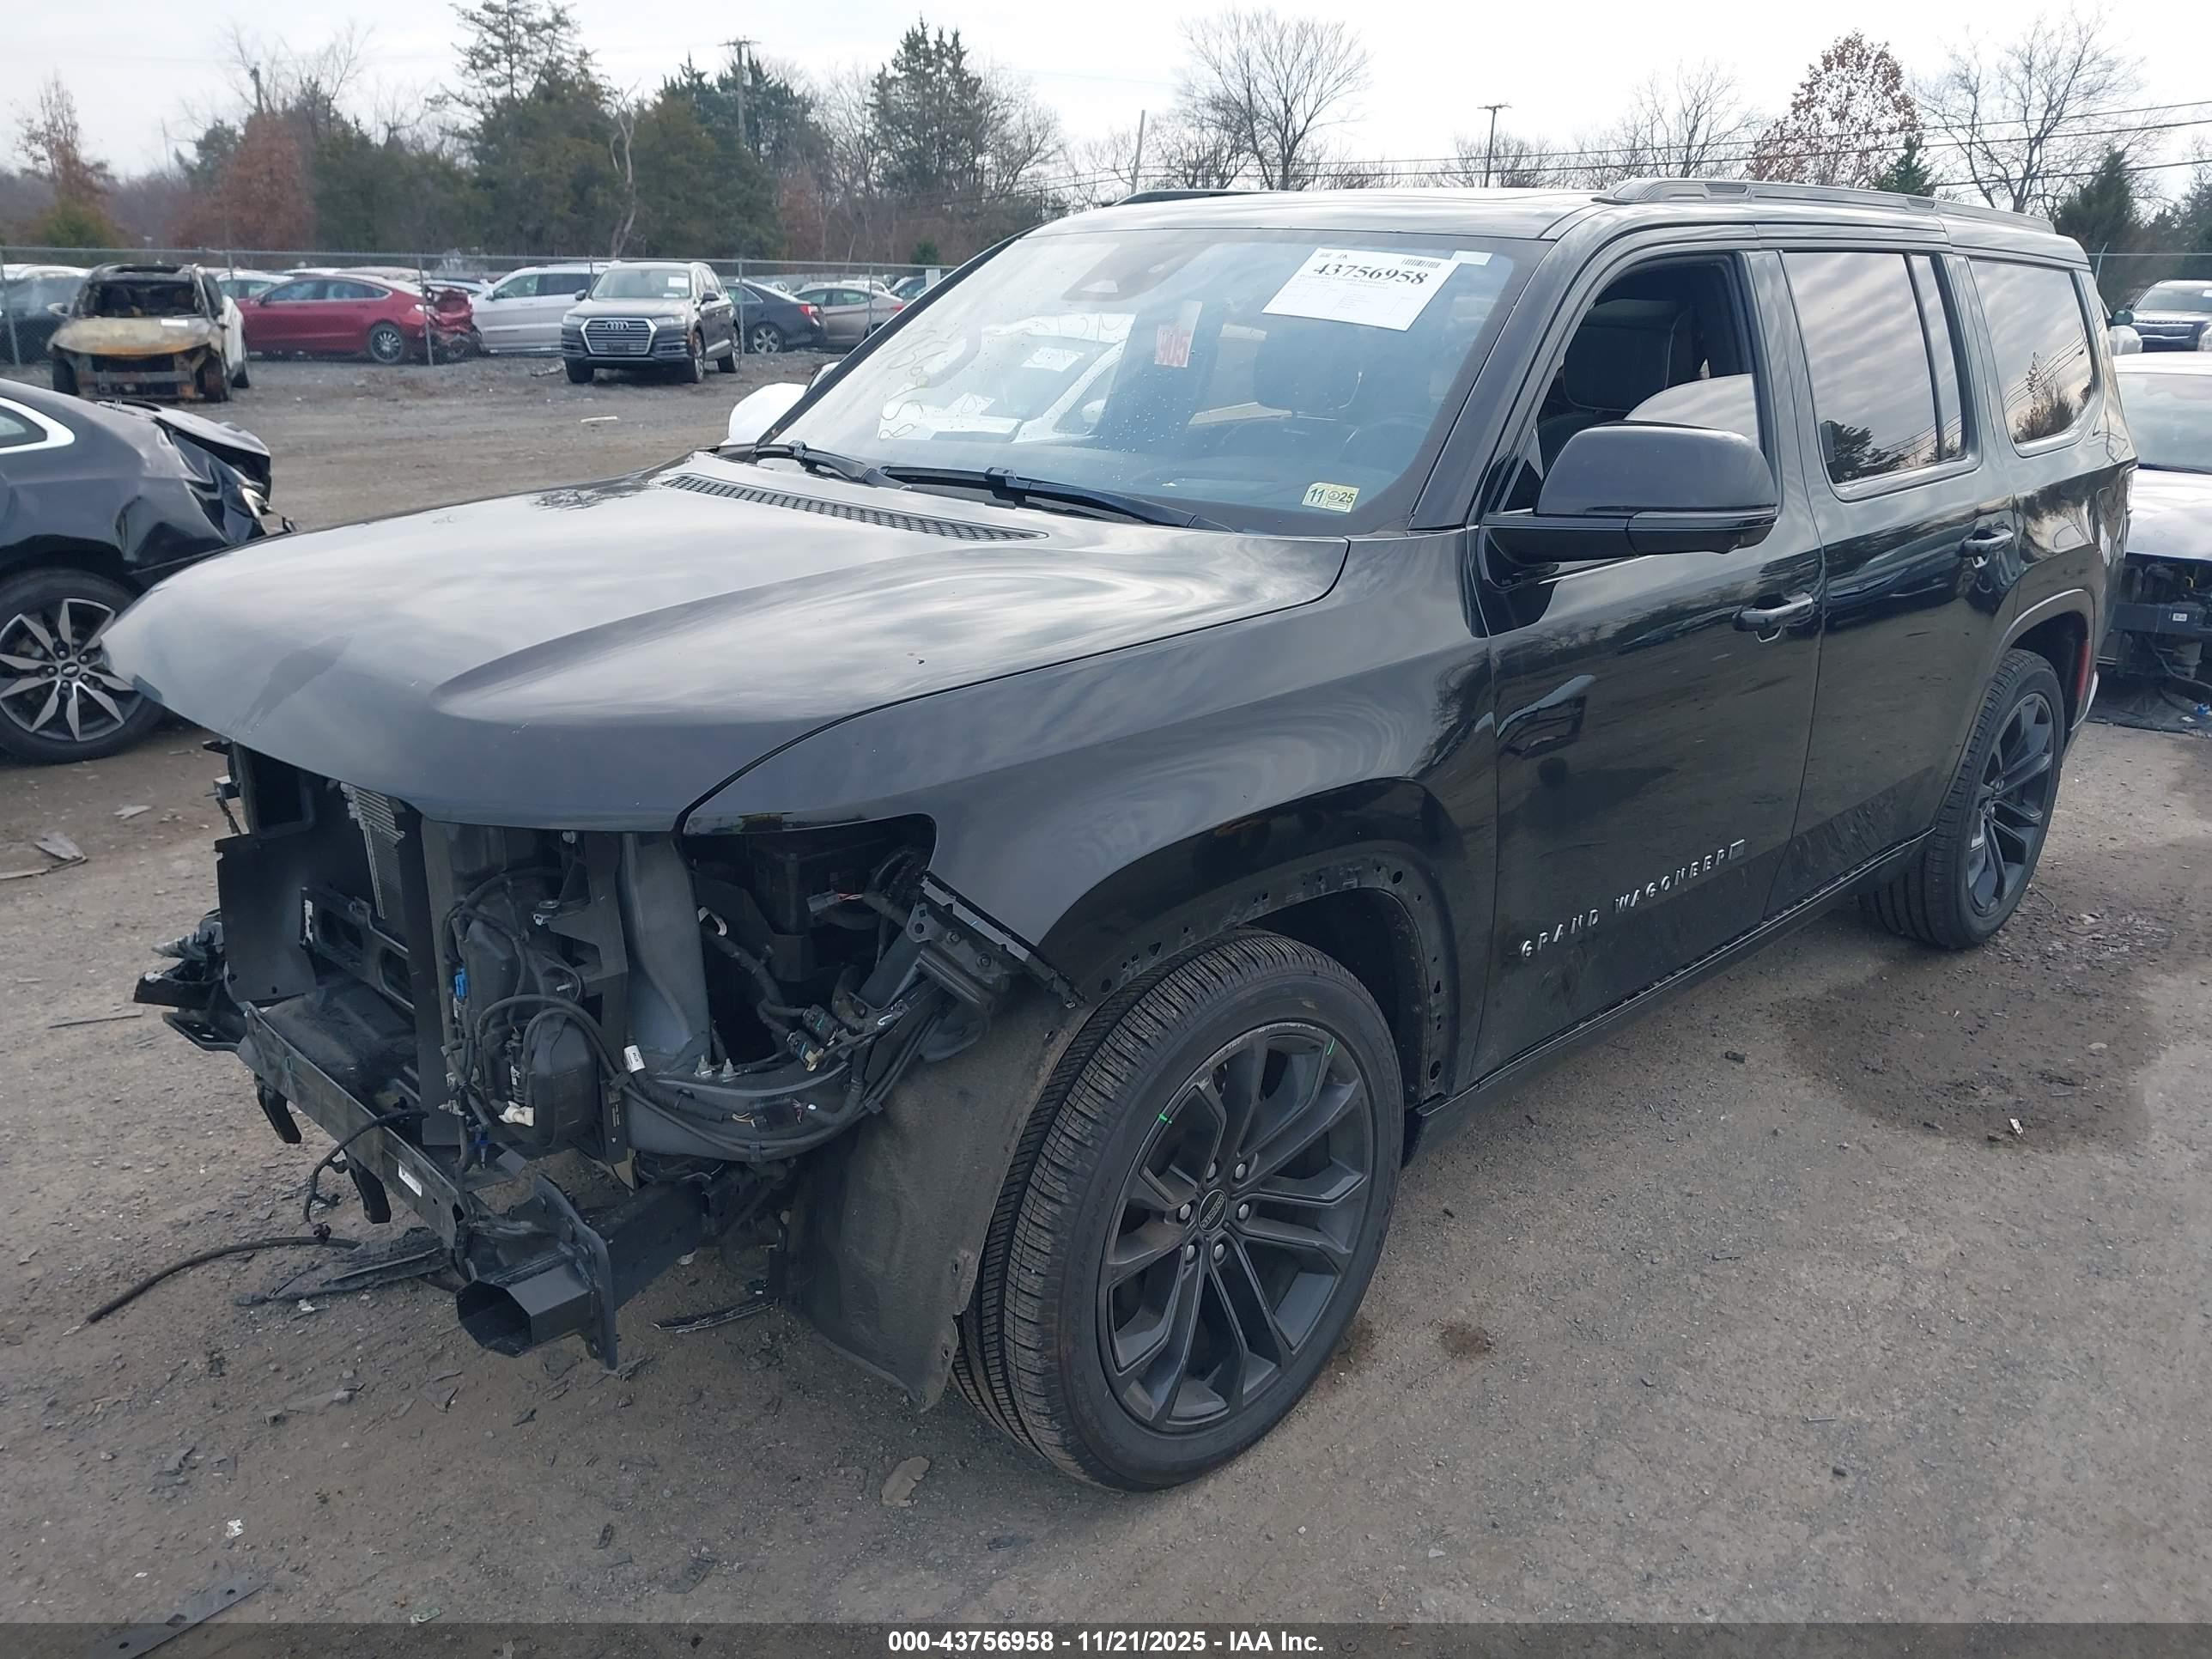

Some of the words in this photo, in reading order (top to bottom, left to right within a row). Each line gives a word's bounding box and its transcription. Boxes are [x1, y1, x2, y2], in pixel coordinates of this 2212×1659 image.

[1313, 263, 1429, 285] 43756958
[1310, 488, 1325, 502] 11
[1339, 492, 1355, 503] 25
[1519, 908, 1599, 957] GRAND
[1614, 848, 1725, 915] WAGONEER
